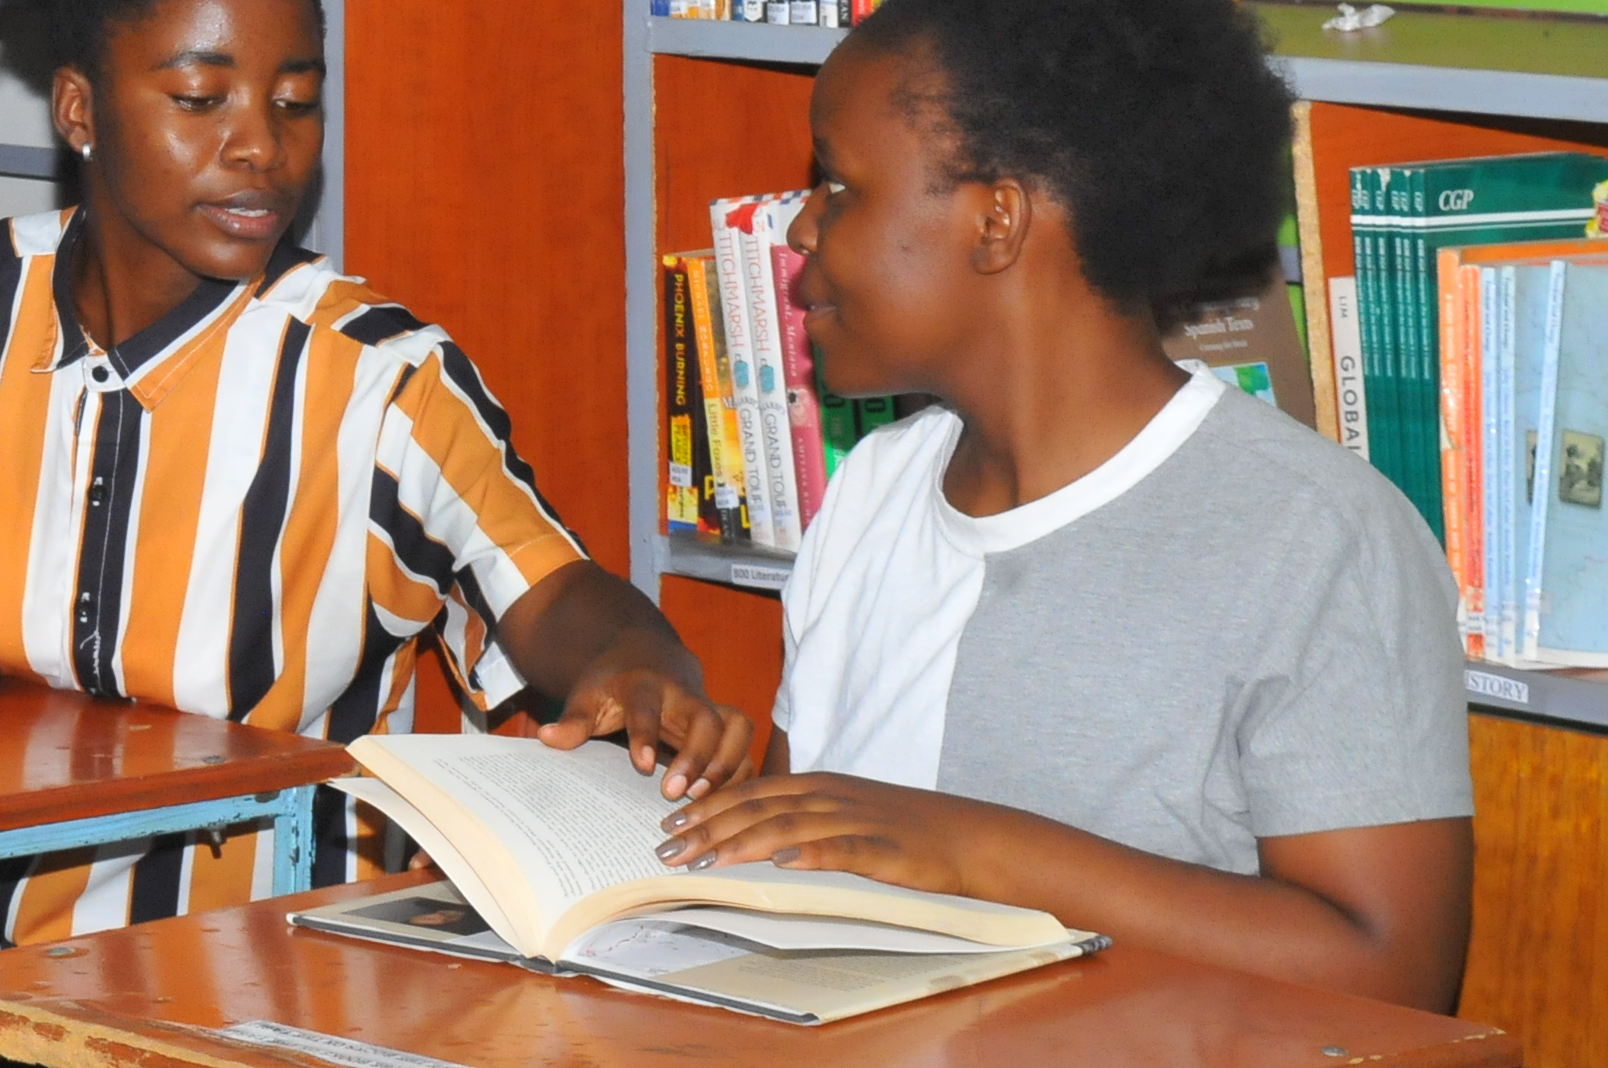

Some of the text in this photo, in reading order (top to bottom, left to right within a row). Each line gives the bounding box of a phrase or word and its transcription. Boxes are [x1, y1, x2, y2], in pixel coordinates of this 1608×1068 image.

[1439, 189, 1474, 213] CGP
[718, 232, 745, 349] TITCHMARSH
[744, 236, 771, 352] TITCHMARSH
[779, 253, 799, 377] Immigrant, Montana
[1338, 295, 1350, 319] LIM
[674, 273, 687, 406] PHOENIX BURNING
[708, 403, 725, 478] Little Foxes
[738, 407, 758, 464] GRAND
[763, 412, 783, 470] GRAND
[734, 568, 749, 580] 800
[1468, 675, 1524, 700] STORY
